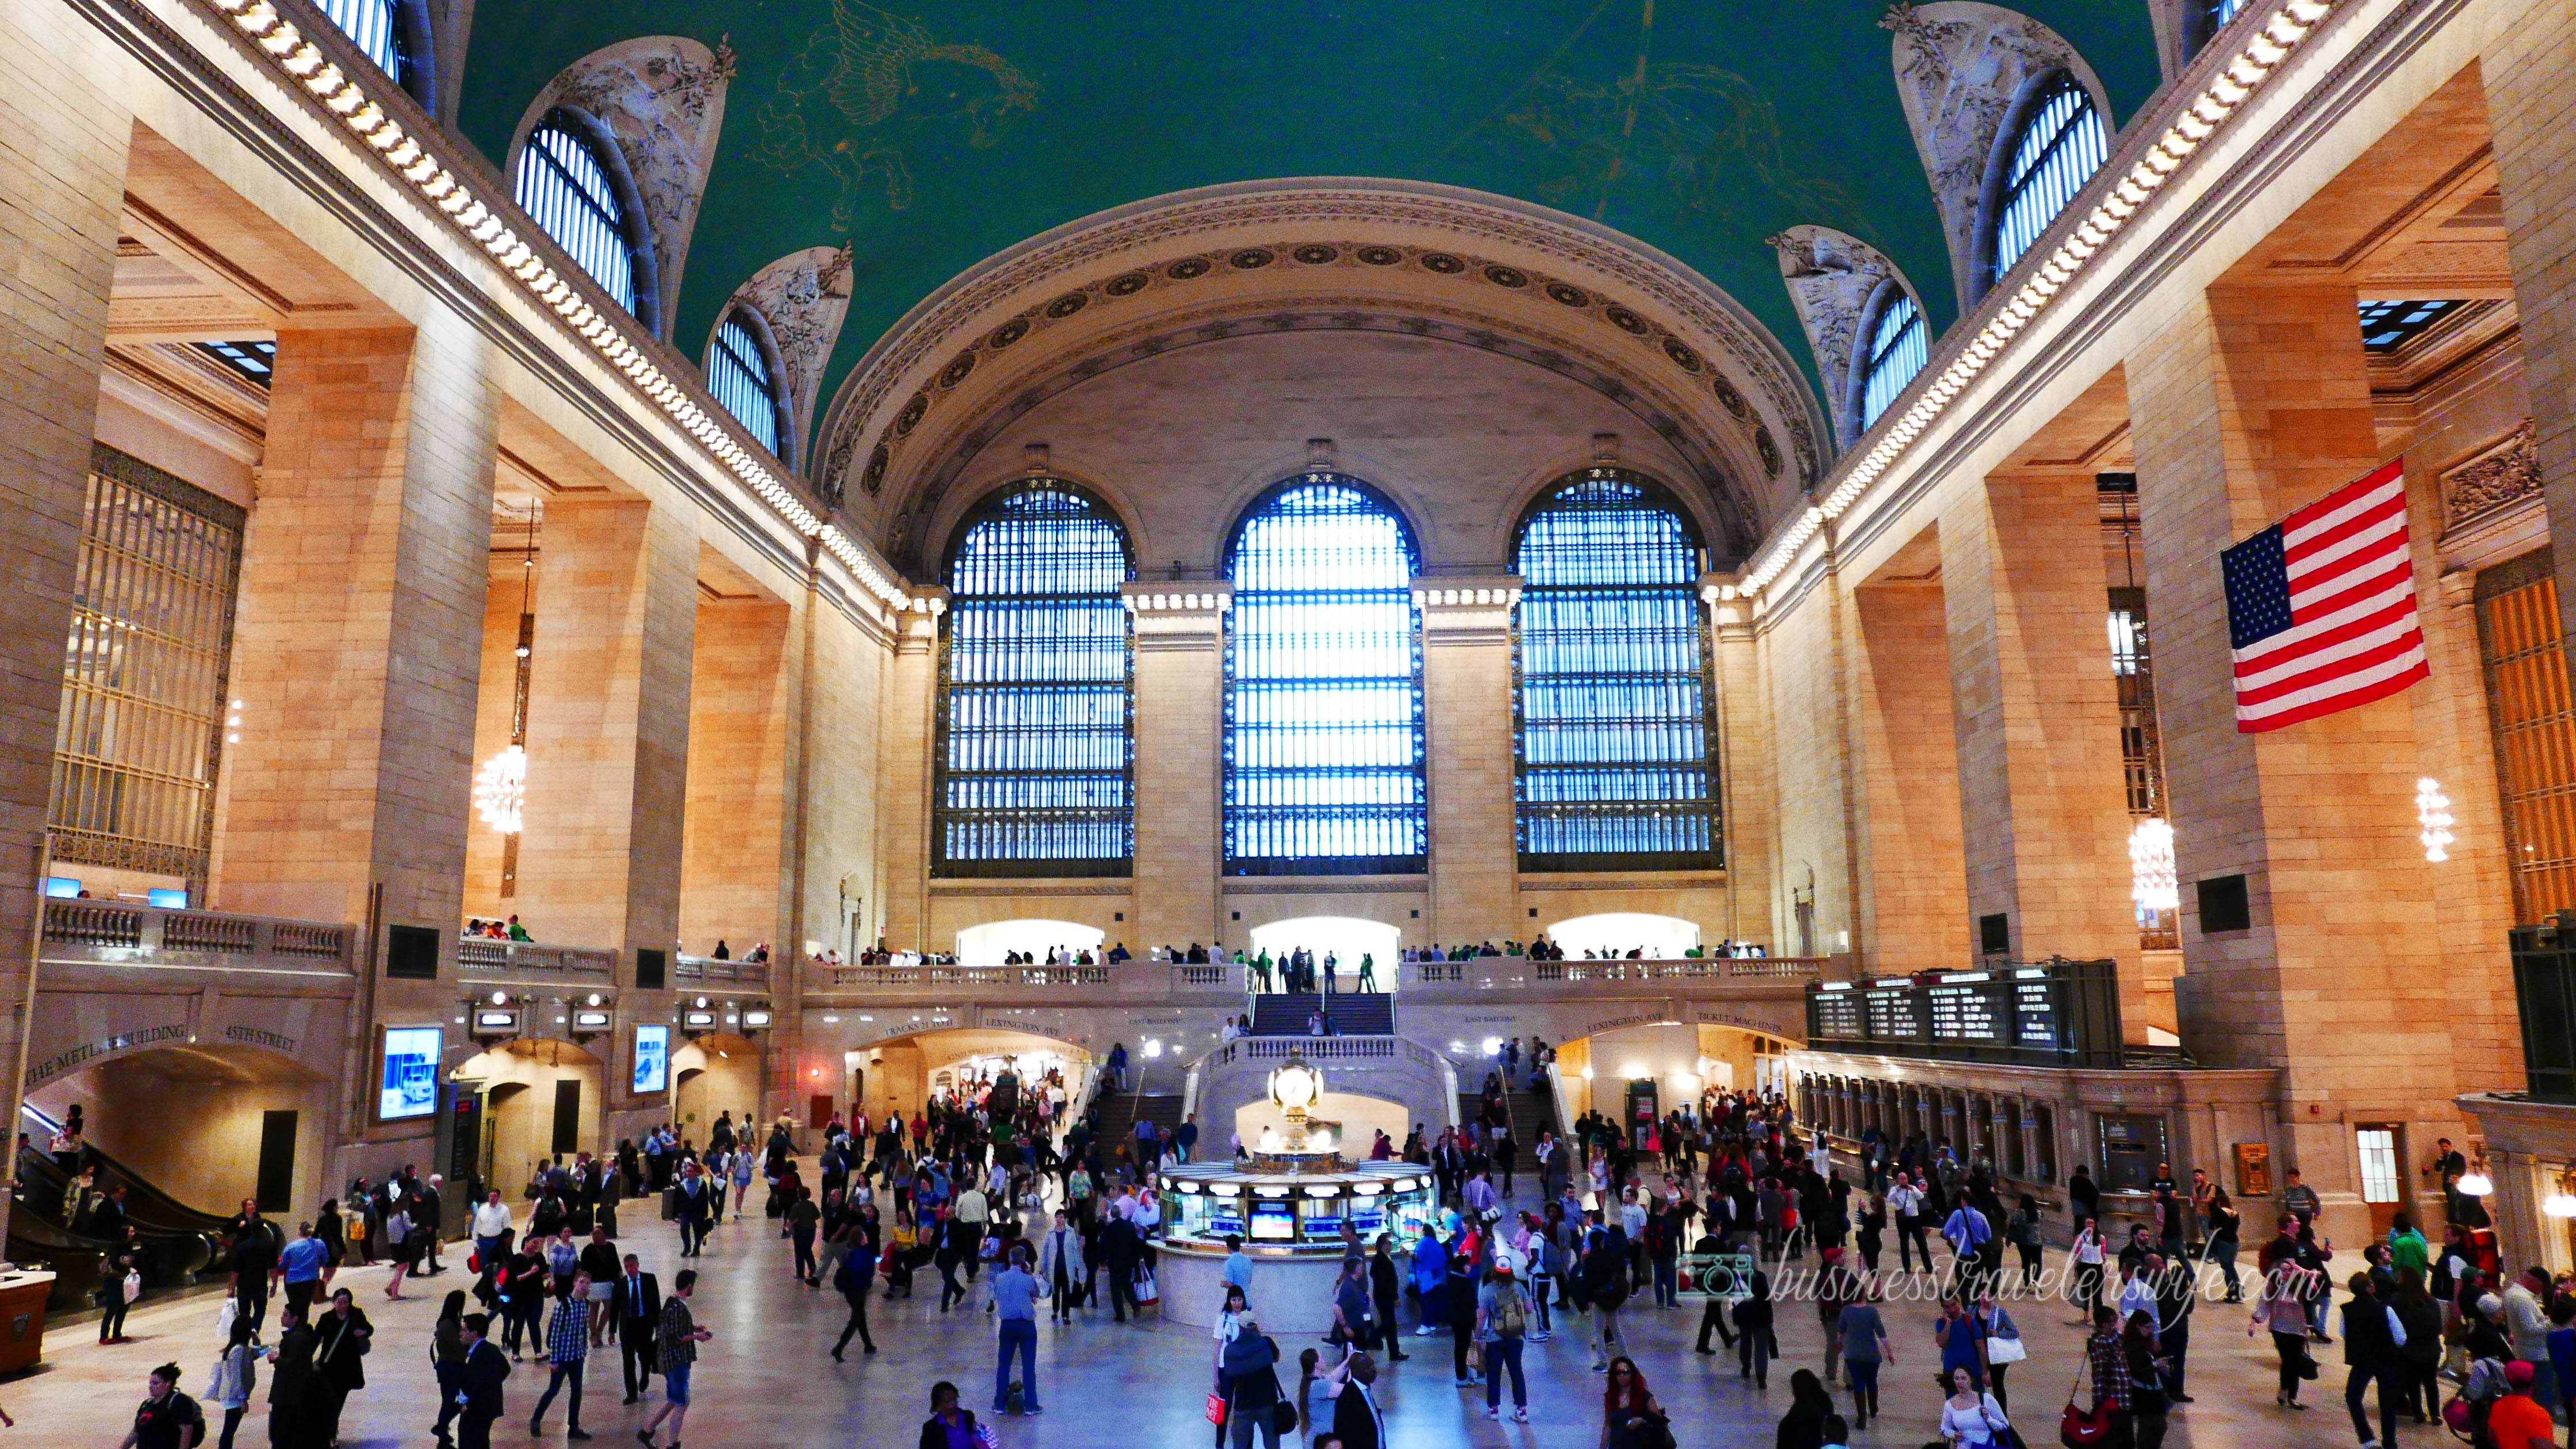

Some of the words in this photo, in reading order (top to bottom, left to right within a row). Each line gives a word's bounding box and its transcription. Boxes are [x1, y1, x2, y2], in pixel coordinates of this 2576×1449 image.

[986, 1018, 1040, 1033] LEXINGTON
[1587, 1015, 1643, 1033] LEXINGTON
[1697, 1012, 1730, 1022] TICKET
[1732, 1015, 1782, 1032] MACHINES
[225, 1026, 254, 1042] 45TH
[256, 1030, 294, 1052] STREET
[25, 1060, 54, 1086] THE
[57, 1037, 118, 1071] METLFE
